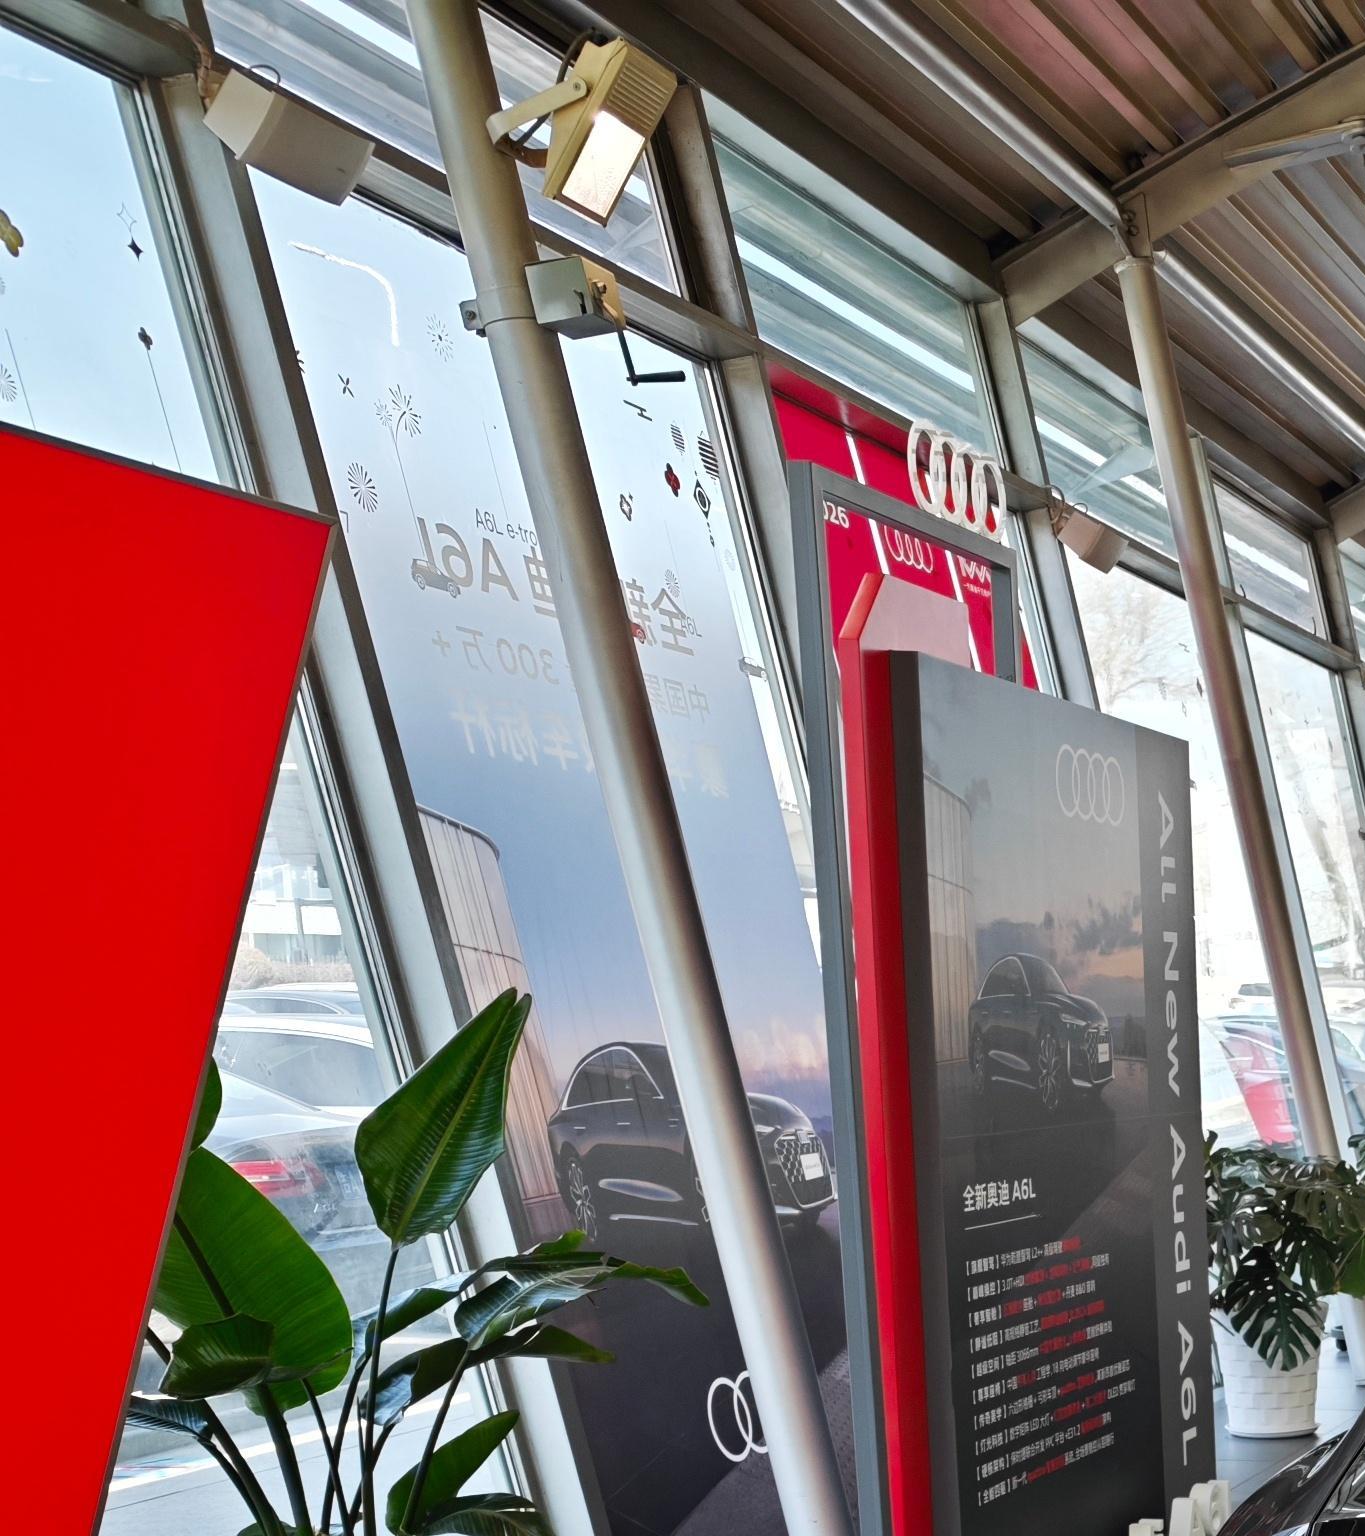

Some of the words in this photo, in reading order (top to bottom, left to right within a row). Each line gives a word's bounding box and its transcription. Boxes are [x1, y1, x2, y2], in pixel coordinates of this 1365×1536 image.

[475, 508, 504, 536] A6L
[506, 523, 540, 547] e-tro
[1162, 931, 1181, 1098] New
[962, 1179, 1010, 1212] 全新奥迪
[1012, 1177, 1037, 1202] A6L
[1169, 1123, 1192, 1295] Audi
[1177, 1320, 1198, 1467] A6L
